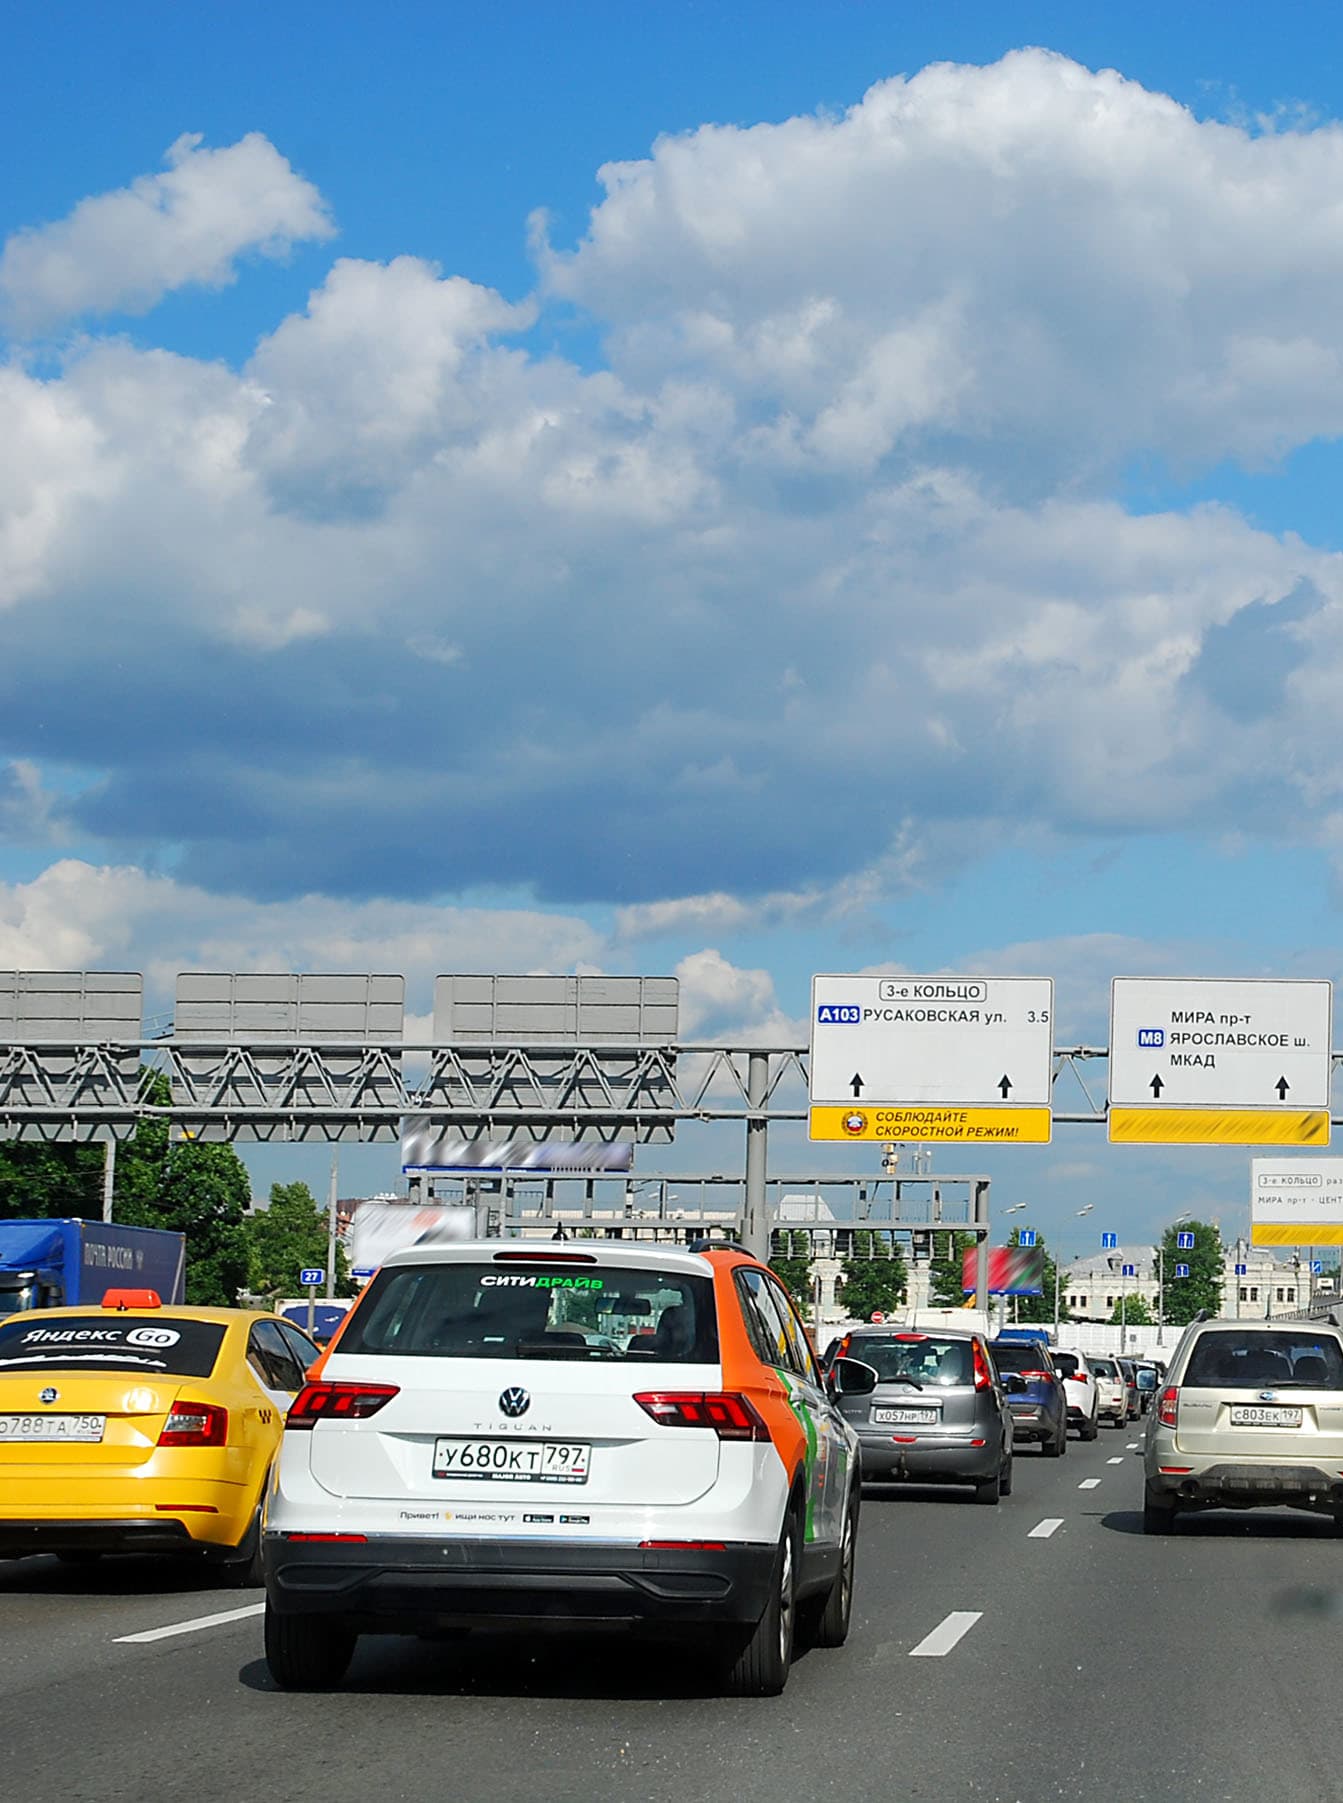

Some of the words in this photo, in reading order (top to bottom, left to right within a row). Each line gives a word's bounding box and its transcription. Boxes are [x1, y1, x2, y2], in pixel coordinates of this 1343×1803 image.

[886, 984, 909, 998] 3-е
[913, 985, 980, 1000] КОЛЬЦО
[863, 1009, 980, 1023] РУСАКОВСКАЯ
[984, 1012, 1007, 1026] ул.
[1027, 1010, 1049, 1023] 3.5
[1171, 1011, 1215, 1024] МИРА
[1220, 1014, 1251, 1027] пр-т
[1170, 1032, 1289, 1047] ЯРОСЛАВСКОЕ
[1293, 1037, 1310, 1047] ш.
[1170, 1054, 1216, 1068] МКАД
[875, 1110, 968, 1123] СОБЛЮДАЙТЕ
[875, 1124, 965, 1137] СКОРОСТНОЙ
[966, 1126, 1019, 1137] РЕЖИМ!
[1281, 1176, 1319, 1185] КОЛЬЦО
[1258, 1196, 1283, 1204] МИРА
[305, 1272, 318, 1281] 27
[480, 1275, 603, 1289] СИТИДРАЙВ
[21, 1328, 123, 1344] Яндекс
[136, 1329, 171, 1343] Go
[1234, 1409, 1280, 1421] С803ЕК
[1282, 1409, 1299, 1420] 197
[72, 1416, 99, 1429] 750
[473, 1423, 552, 1431] TIGUAN
[446, 1444, 540, 1470] У680КТ
[546, 1446, 584, 1465] 797
[552, 1464, 571, 1472] RUS
[399, 1511, 439, 1521] Привет!
[499, 1514, 516, 1523] тут
